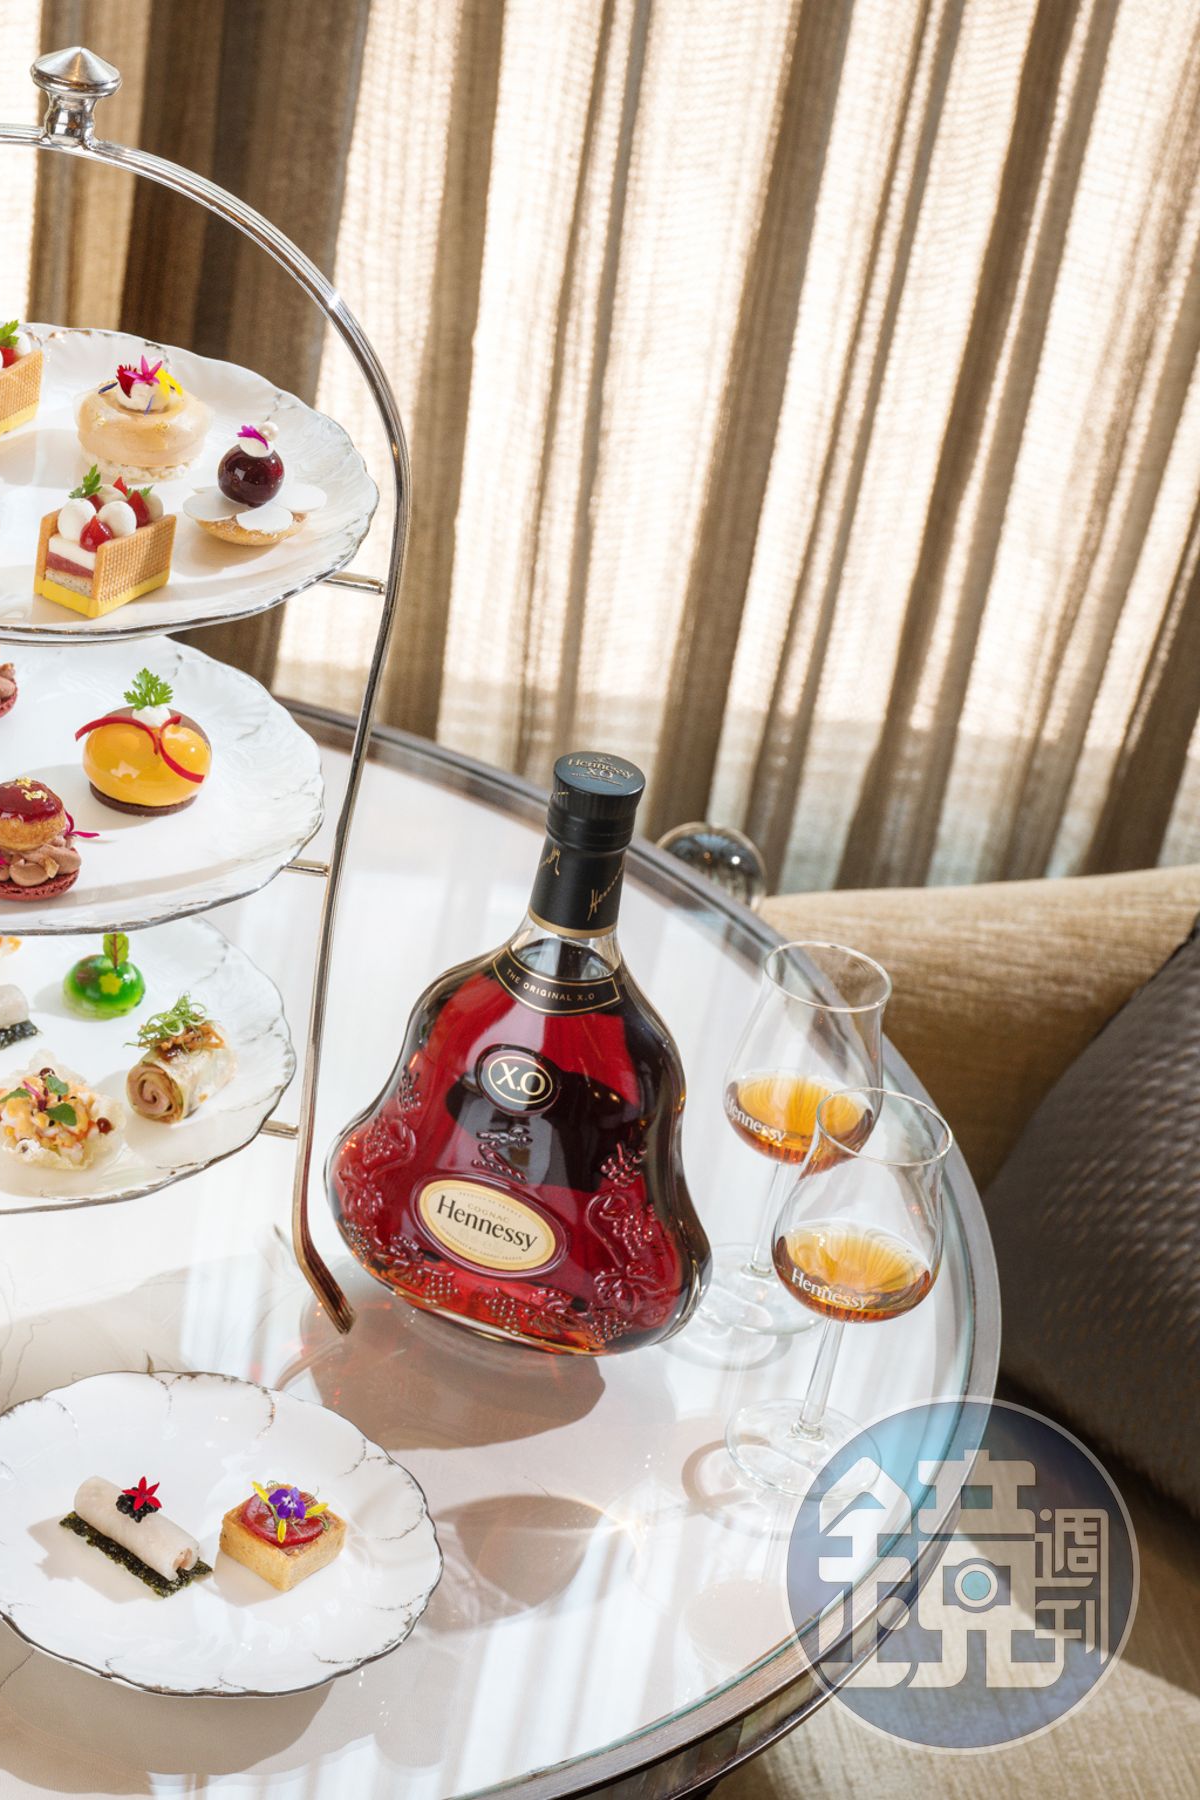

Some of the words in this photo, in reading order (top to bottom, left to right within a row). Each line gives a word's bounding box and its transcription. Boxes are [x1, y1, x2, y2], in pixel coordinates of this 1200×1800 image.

[505, 968, 521, 984] THE
[523, 982, 572, 1001] ORIGINAL
[495, 1061, 546, 1096] X.O
[436, 1194, 538, 1252] Hennessy
[467, 1202, 511, 1223] COGNAC
[791, 1267, 869, 1311] Hennessy
